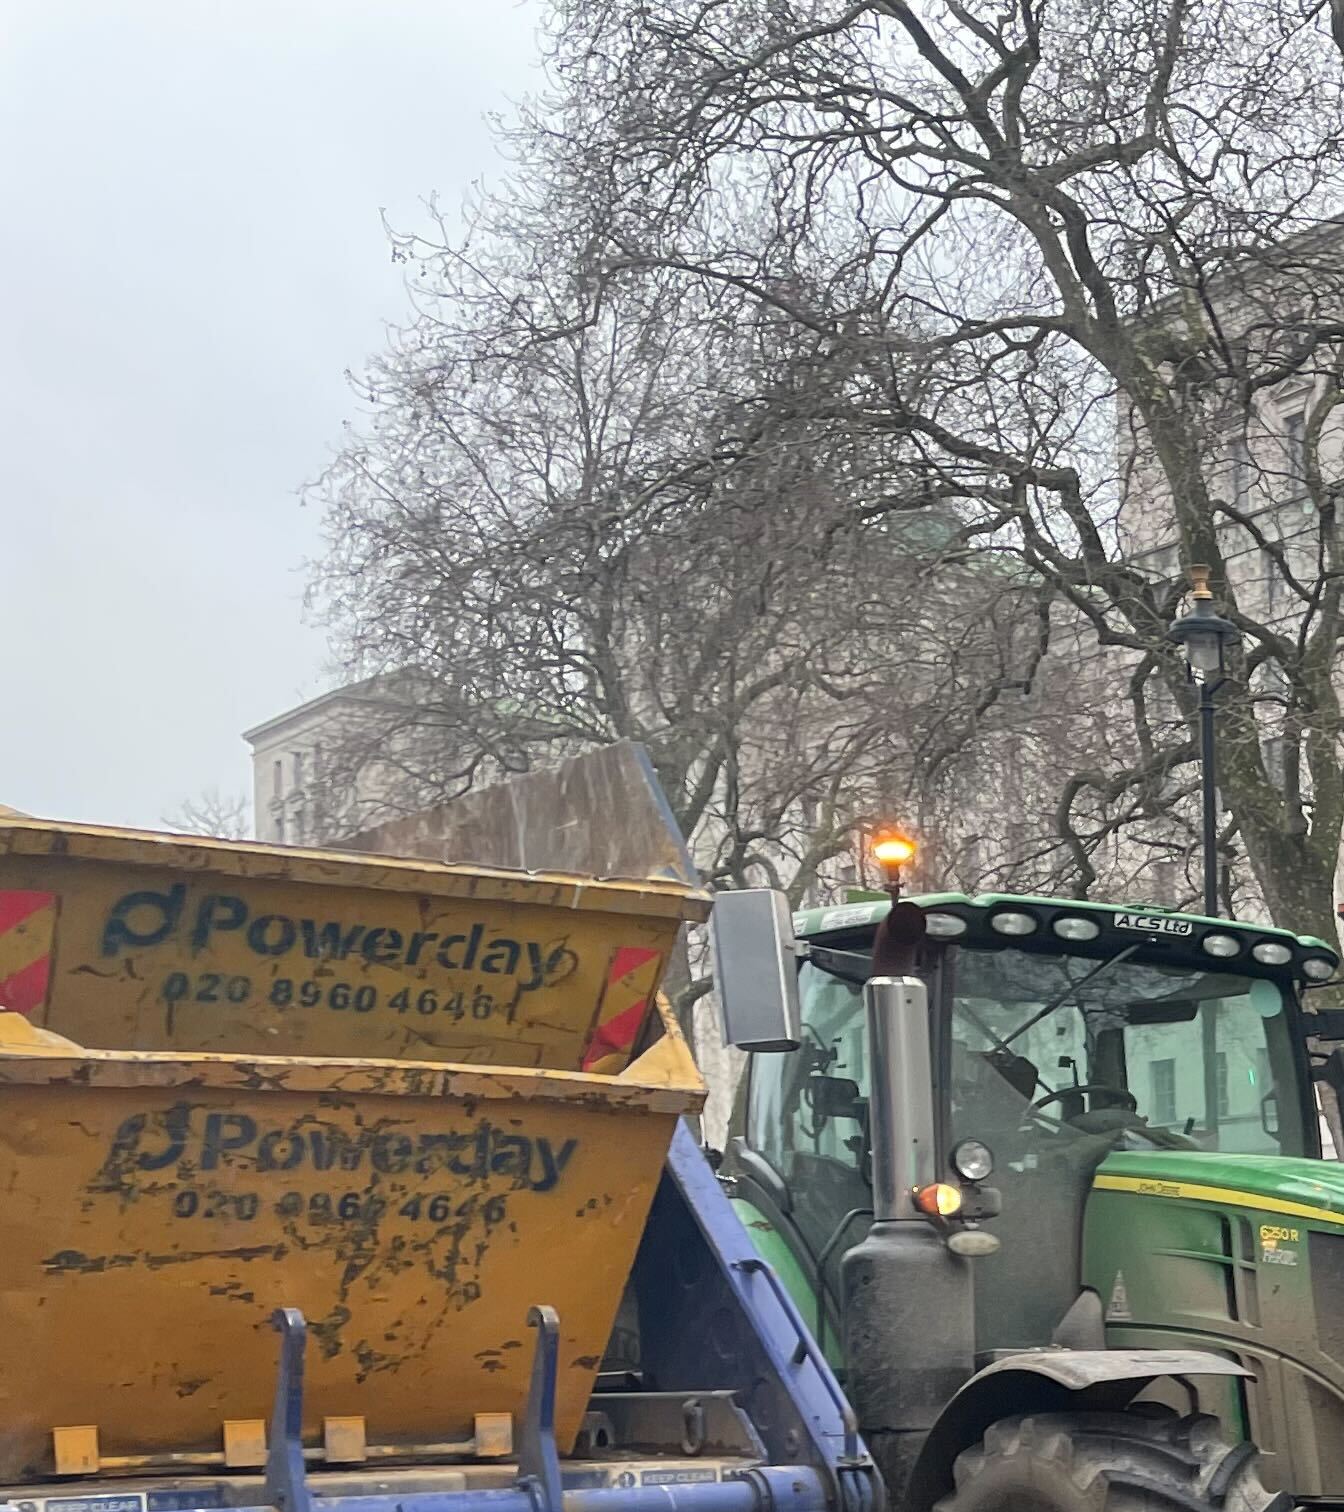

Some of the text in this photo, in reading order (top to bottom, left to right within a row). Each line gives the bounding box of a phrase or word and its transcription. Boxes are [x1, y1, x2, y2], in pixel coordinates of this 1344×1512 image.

[190, 894, 569, 990] Powerday
[1164, 920, 1189, 934] Ltd
[161, 970, 250, 1004] 020
[267, 977, 378, 1013] 8960
[200, 1112, 578, 1192] Powerday
